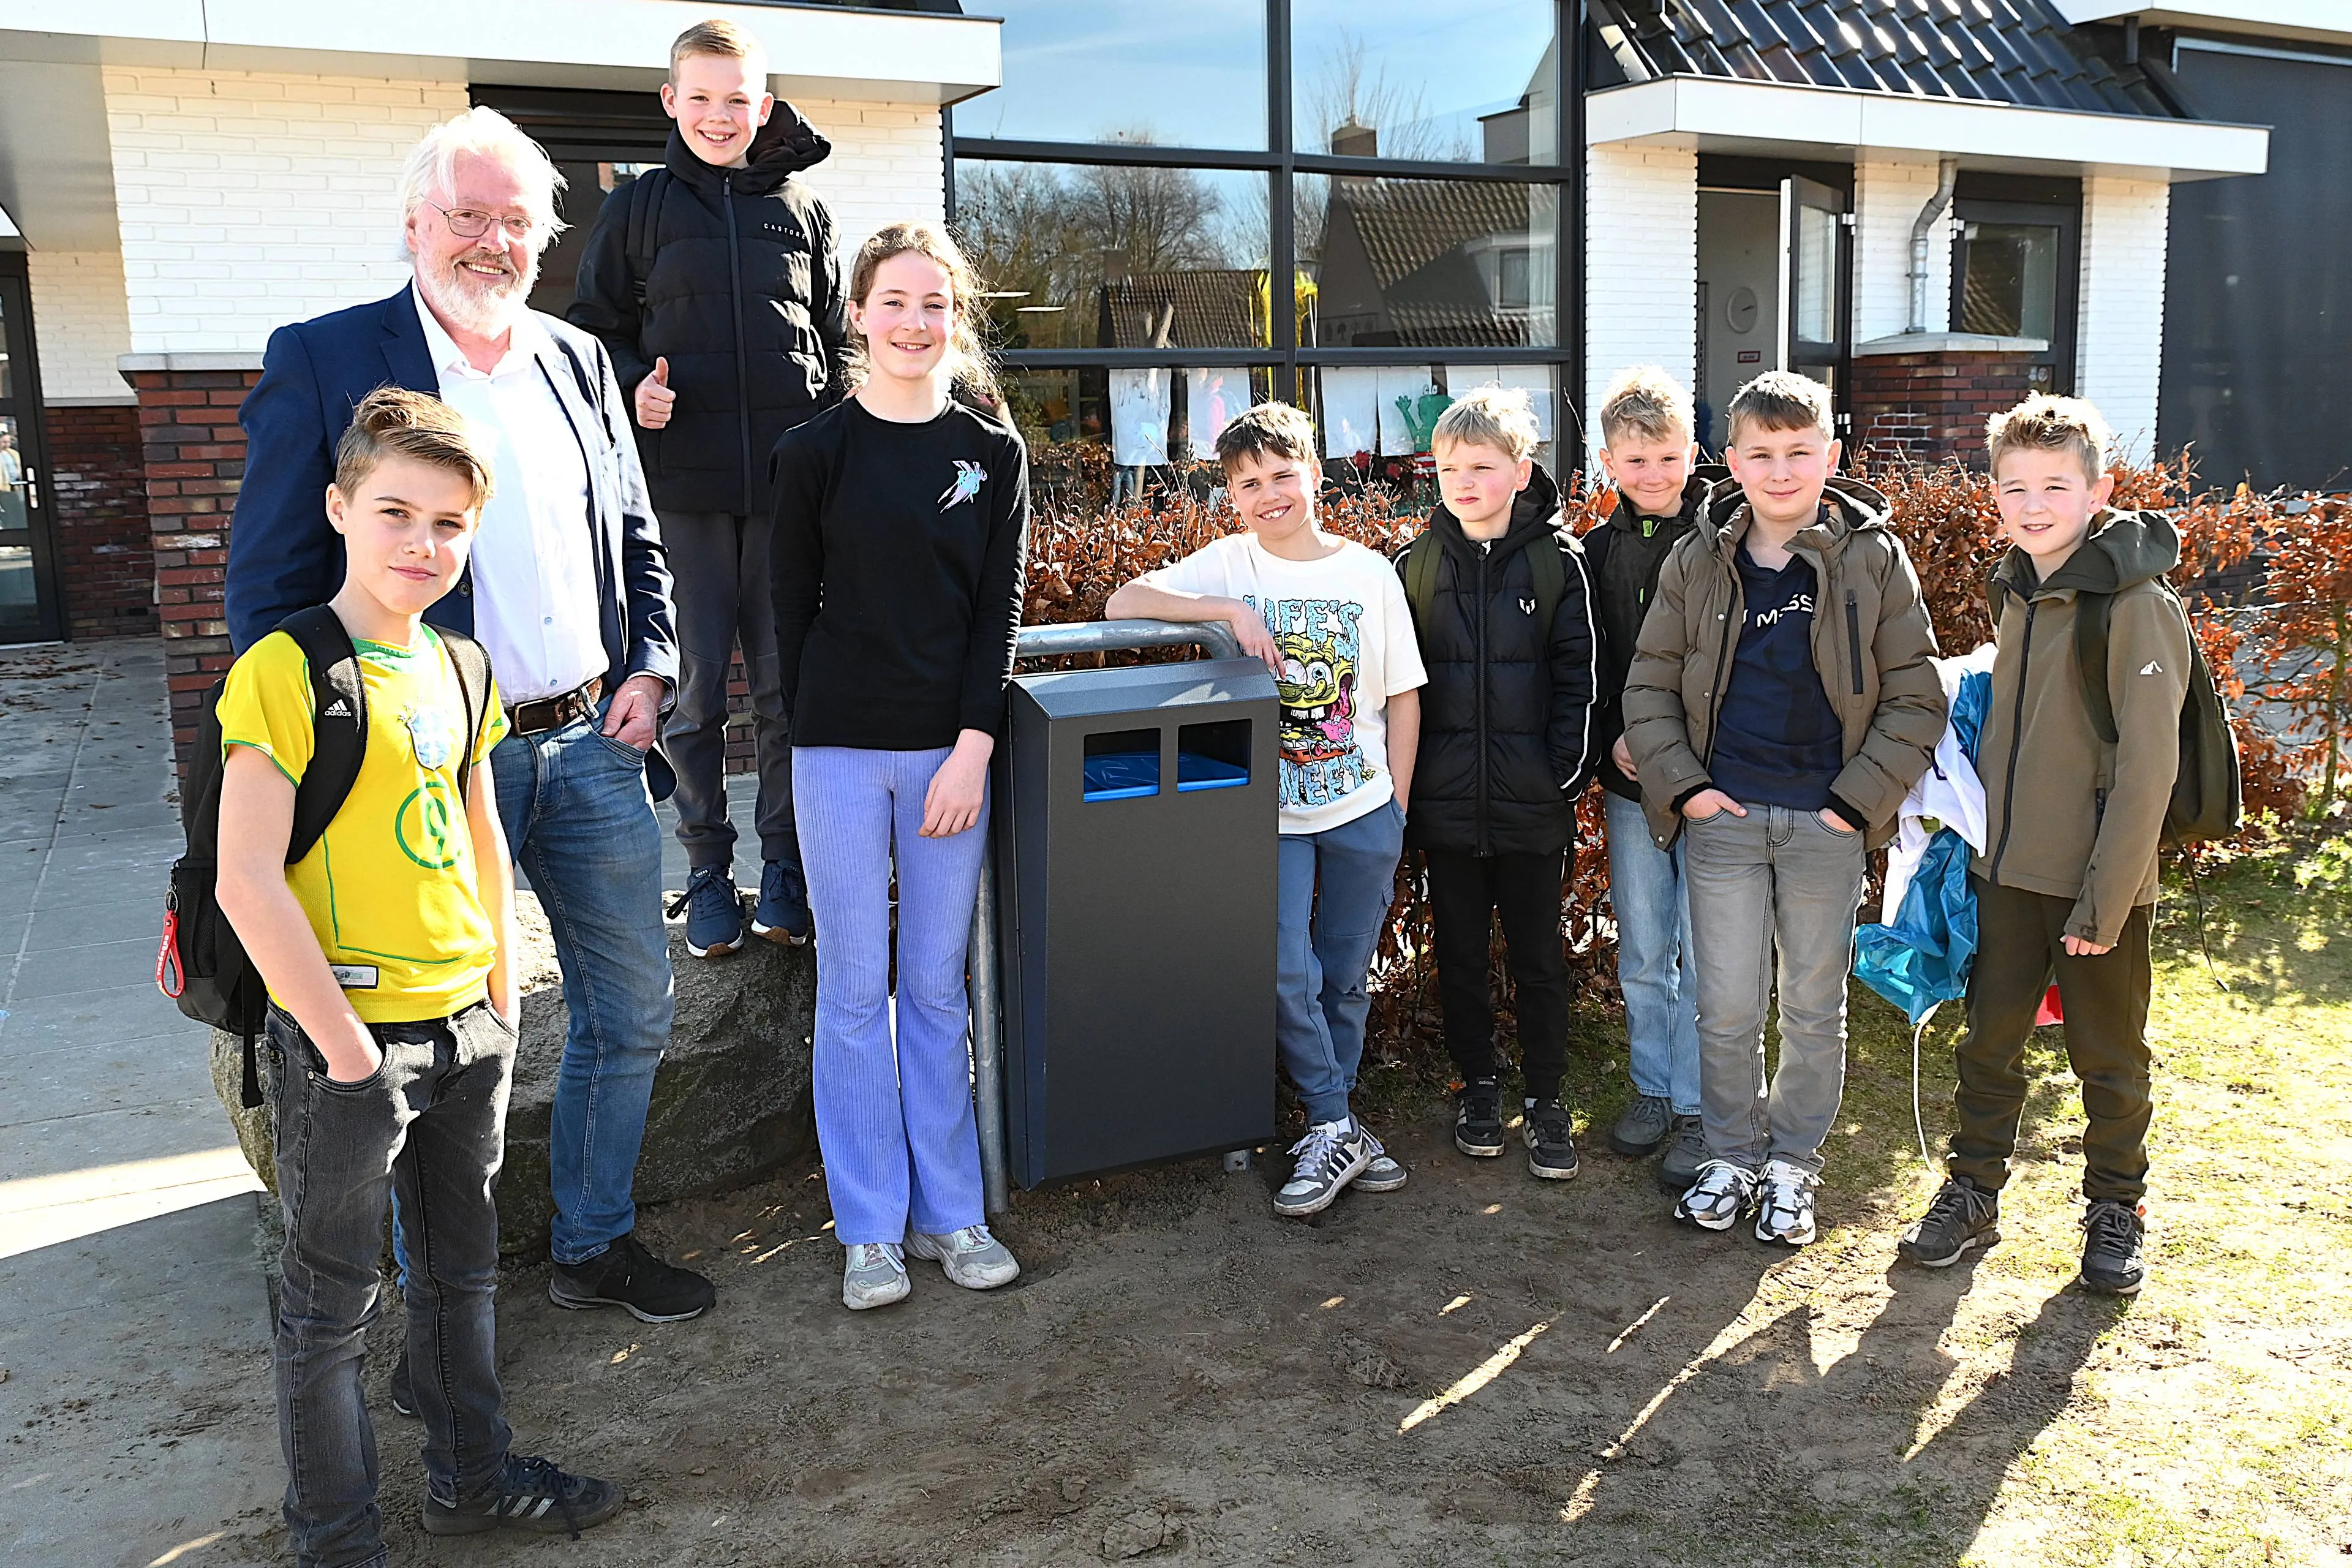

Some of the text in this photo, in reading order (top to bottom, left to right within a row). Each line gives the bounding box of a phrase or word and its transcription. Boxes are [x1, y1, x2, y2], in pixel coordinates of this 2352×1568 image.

[764, 223, 806, 239] CASTORE
[1757, 594, 1814, 627] MSS
[426, 797, 446, 856] 9
